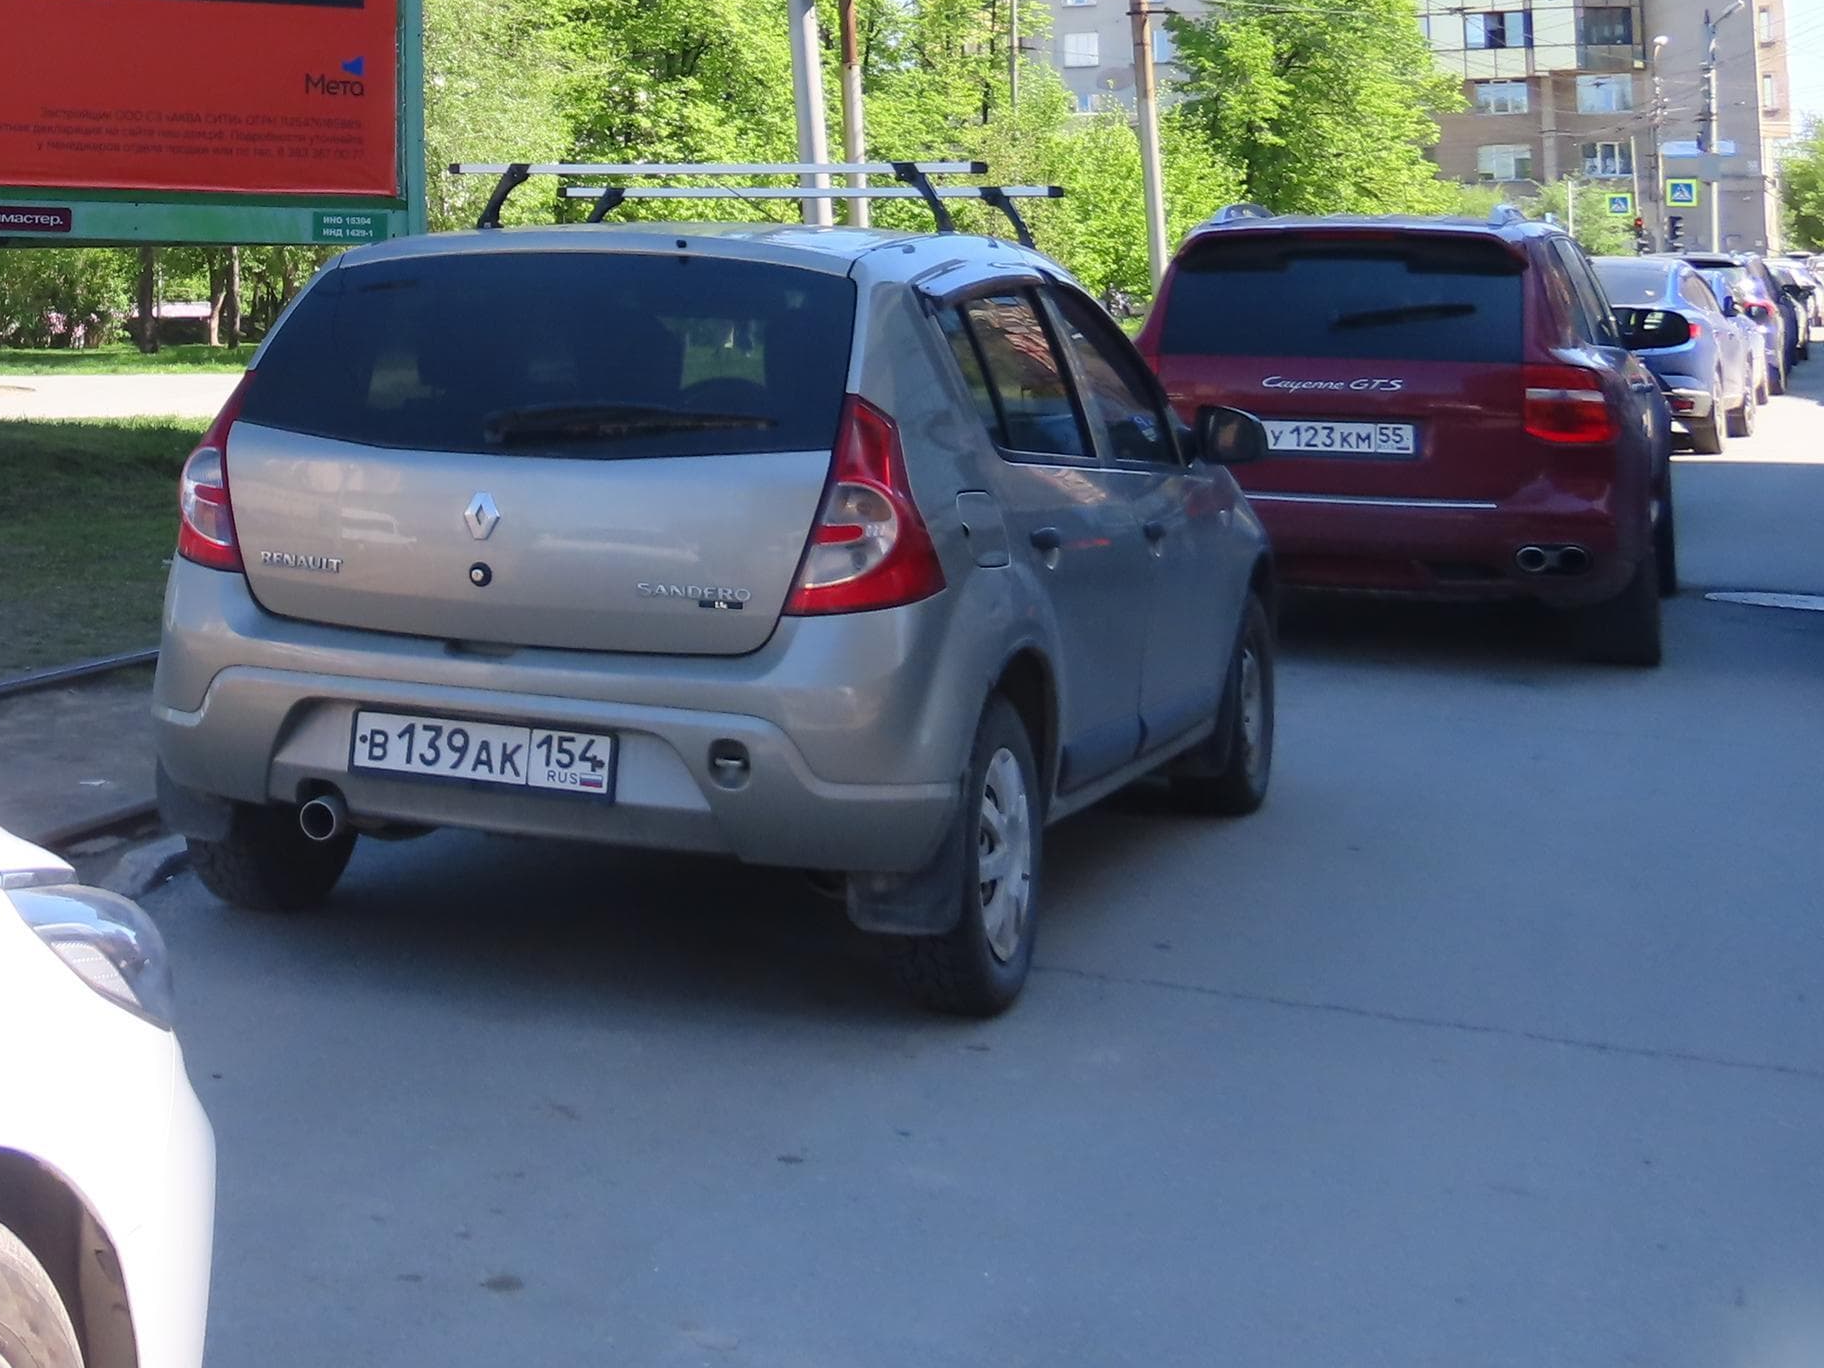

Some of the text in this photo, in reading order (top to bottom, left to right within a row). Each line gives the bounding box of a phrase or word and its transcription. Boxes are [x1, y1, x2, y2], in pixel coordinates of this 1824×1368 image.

[304, 73, 365, 97] Мета
[1262, 375, 1404, 394] Cayenne GTS
[1378, 426, 1405, 444] 55
[260, 551, 344, 573] RENAULT
[636, 582, 752, 602] SANDERO
[535, 733, 601, 773] 154
[546, 769, 578, 784] RUS
